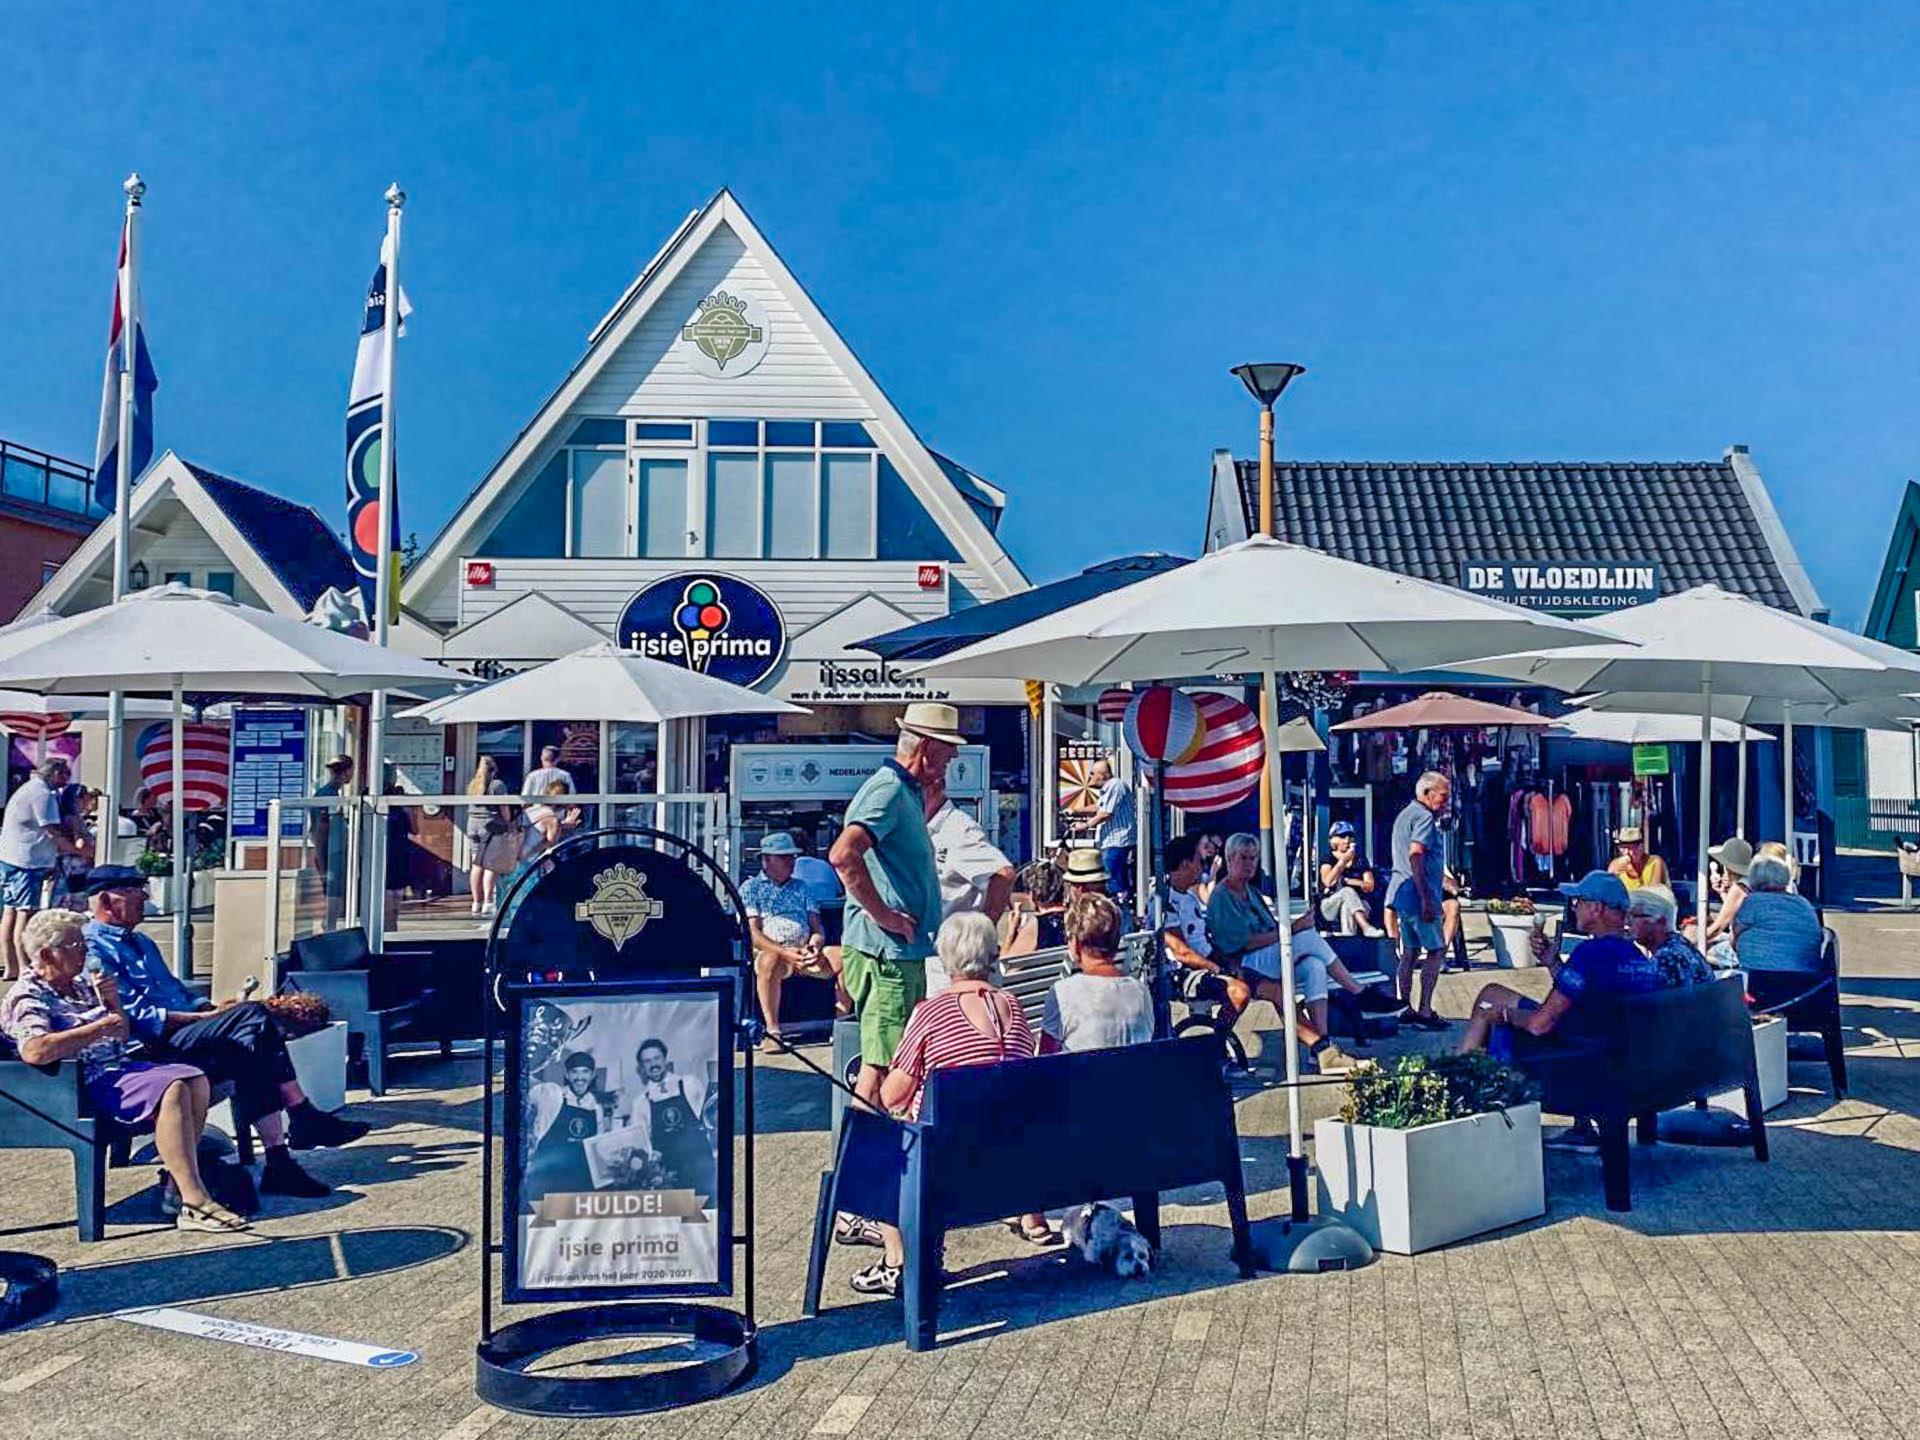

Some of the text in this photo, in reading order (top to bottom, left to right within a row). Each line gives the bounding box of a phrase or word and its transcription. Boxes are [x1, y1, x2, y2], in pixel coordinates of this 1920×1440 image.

[469, 566, 490, 583] illy
[920, 568, 939, 584] illy
[1468, 567, 1654, 589] DE VLOEDLIJN
[631, 632, 771, 661] ijsie prima
[820, 660, 925, 688] ijssalo
[575, 1193, 664, 1217] HULDE!
[559, 1235, 679, 1261] ijsie prima
